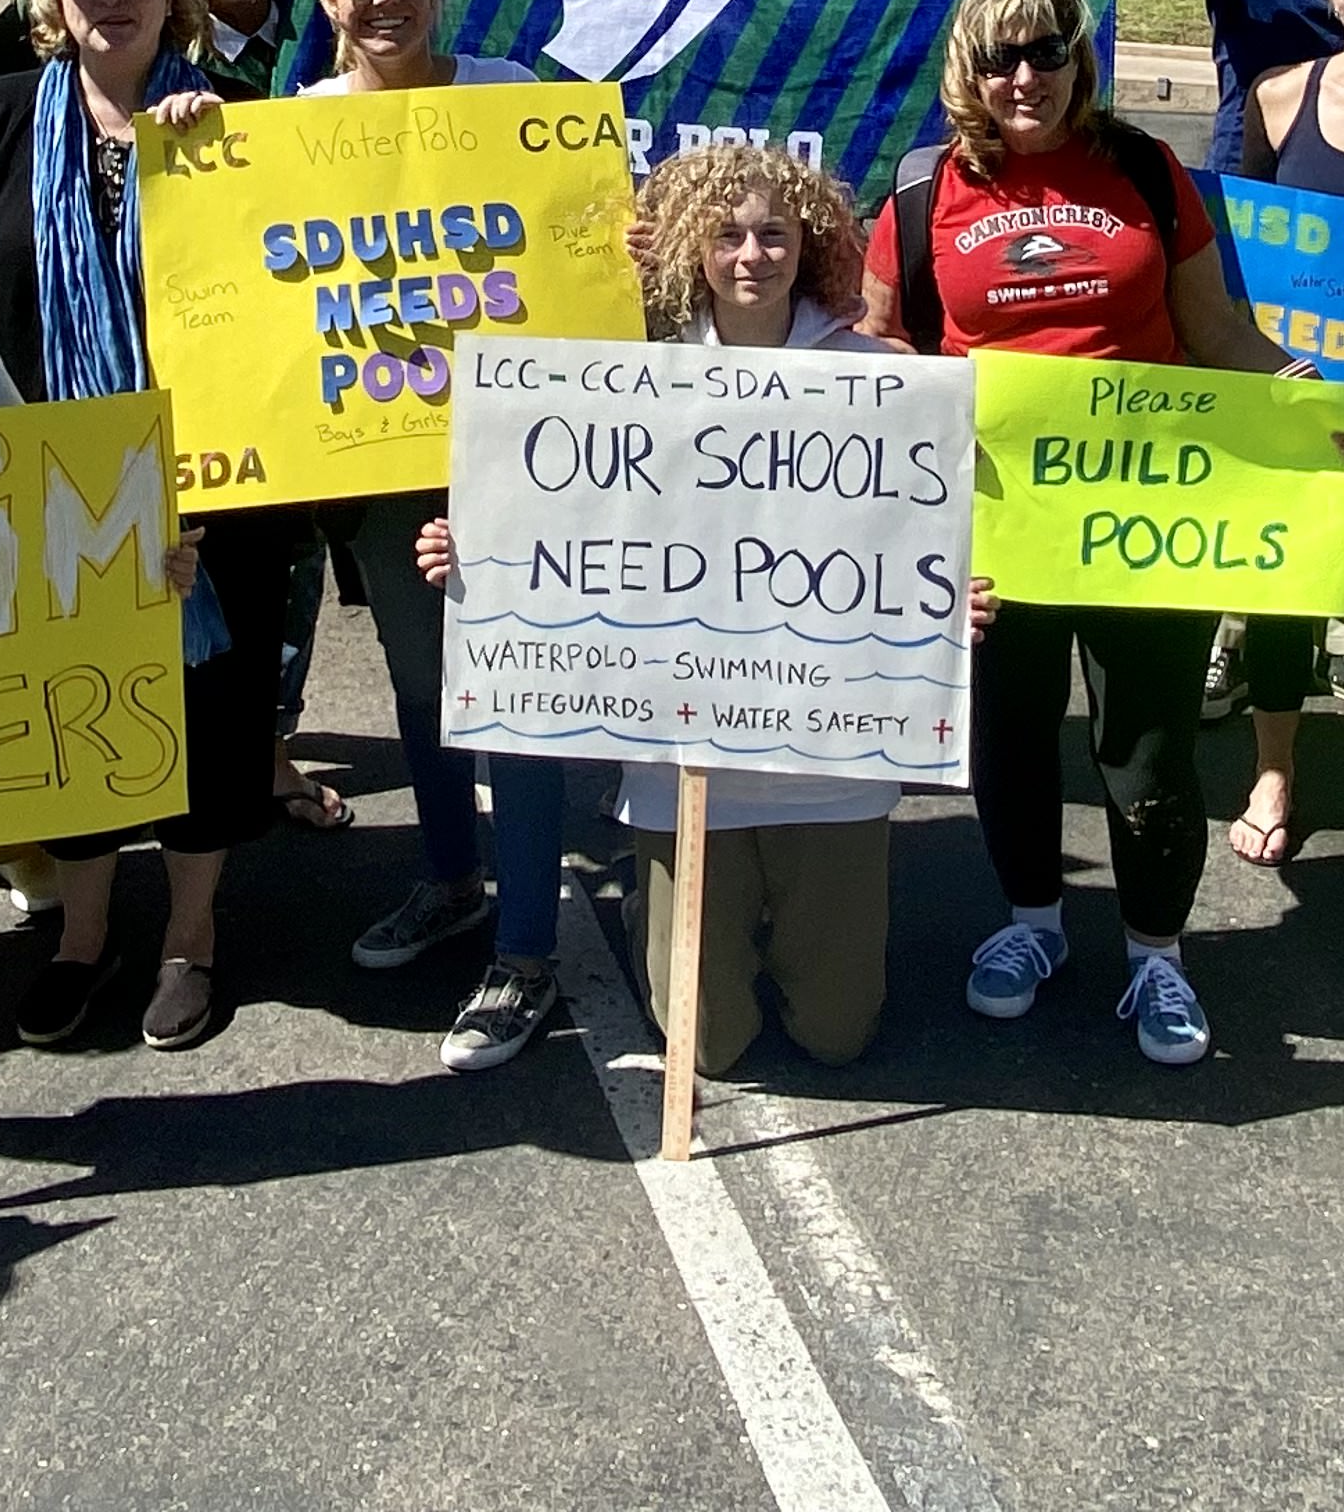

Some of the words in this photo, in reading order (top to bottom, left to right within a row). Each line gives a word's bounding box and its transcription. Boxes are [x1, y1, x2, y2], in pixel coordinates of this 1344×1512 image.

[163, 131, 252, 180] LCC
[519, 112, 624, 154] CCA
[263, 202, 525, 276] SDUHSD
[548, 224, 593, 242] Dive
[564, 241, 614, 258] Team
[954, 206, 1049, 255] CANYON
[1049, 204, 1125, 239] CREST
[166, 273, 239, 305] Swim
[315, 269, 526, 336] NEEDS
[986, 285, 1037, 305] SWIM
[1063, 279, 1109, 297] DIVE
[1290, 271, 1324, 290] Water
[174, 306, 236, 331] Team
[320, 346, 452, 408] POO
[1090, 375, 1218, 417] Please
[314, 423, 366, 445] Boys
[401, 410, 450, 433] Girls
[175, 447, 267, 492] SDA
[524, 415, 662, 496] OUR
[693, 424, 949, 506] SCHOOLS
[1031, 435, 1212, 487] BUILD
[1080, 509, 1290, 571] POOLS
[529, 538, 708, 595] NEED
[735, 537, 958, 621] POOLS
[673, 651, 833, 689] SWIMMING
[491, 691, 656, 723] LIFEGUARDS
[711, 703, 793, 732] WATER
[806, 708, 911, 737] SAFETY
